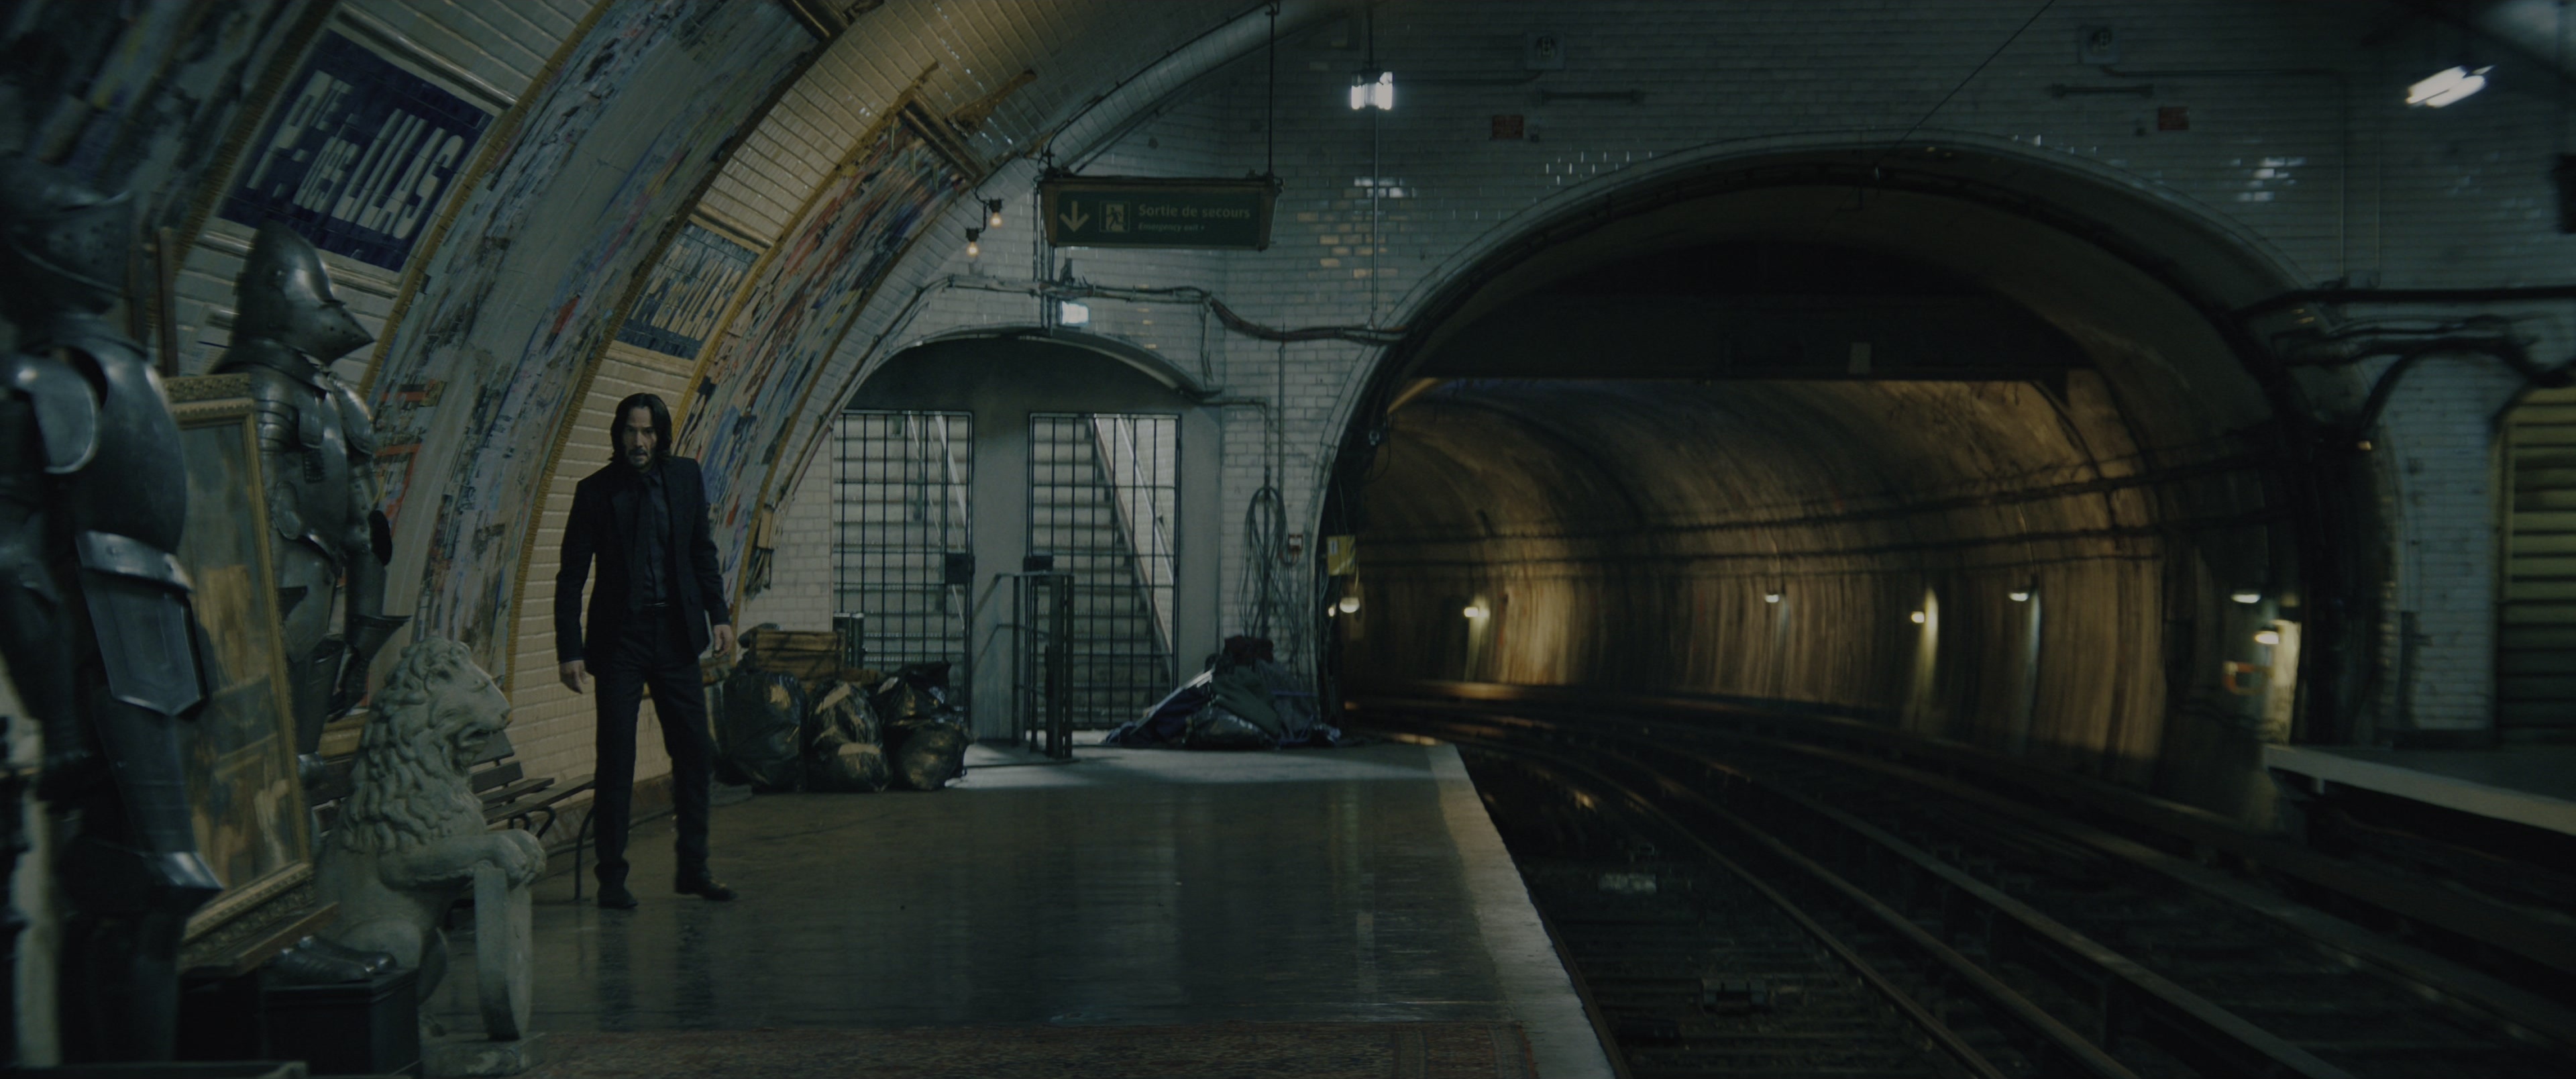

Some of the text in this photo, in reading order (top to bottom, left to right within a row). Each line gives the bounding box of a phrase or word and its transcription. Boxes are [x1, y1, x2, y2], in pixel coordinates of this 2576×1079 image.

[330, 107, 466, 240] LILAS
[1139, 204, 1250, 219] Sortie de secours
[1138, 222, 1198, 232] Emergency exit
